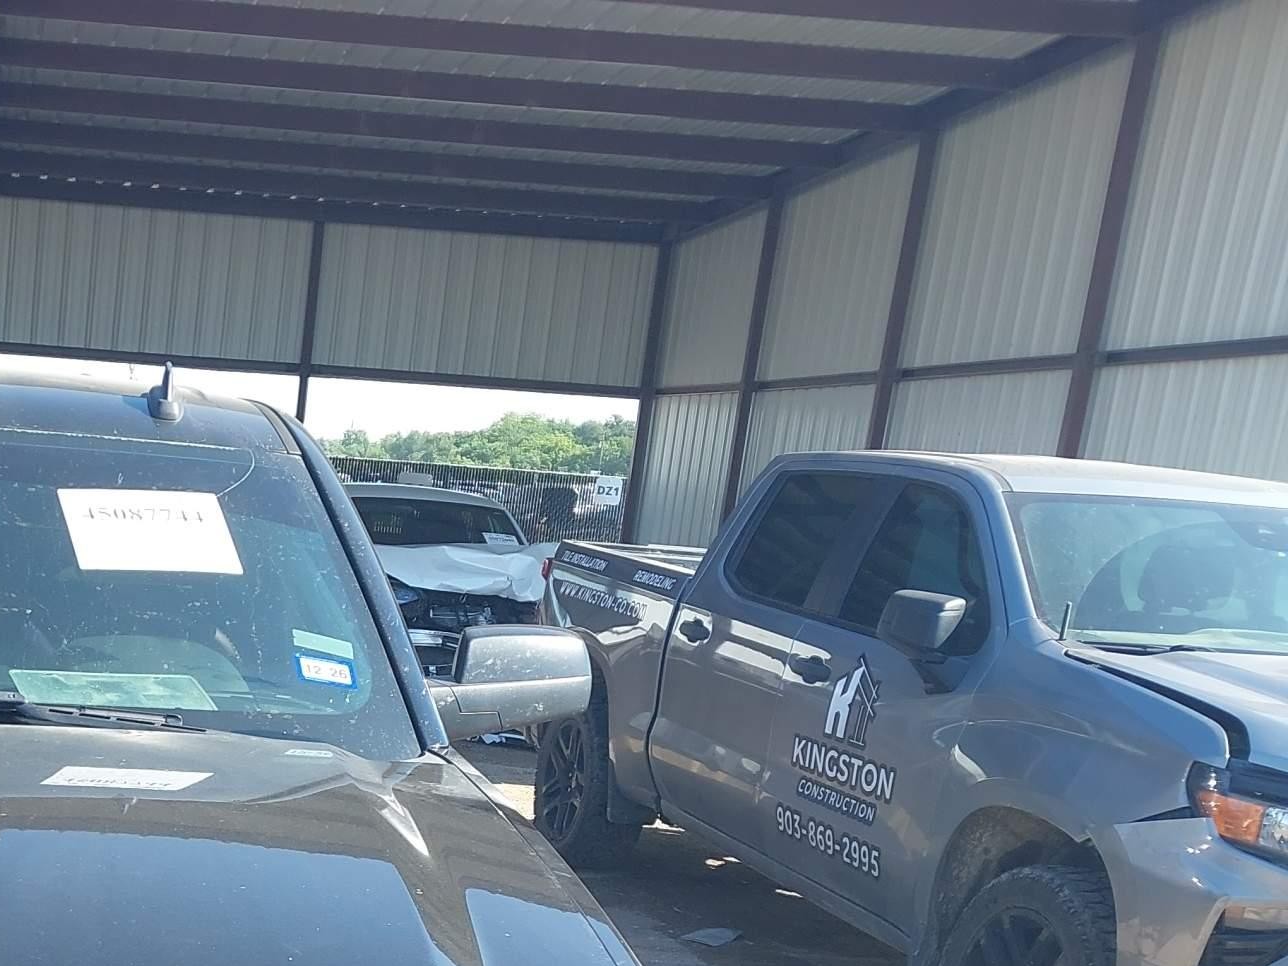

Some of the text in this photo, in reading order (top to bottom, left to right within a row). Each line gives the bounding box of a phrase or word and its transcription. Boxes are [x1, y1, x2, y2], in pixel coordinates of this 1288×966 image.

[597, 486, 619, 496] DZ1
[561, 550, 609, 572] TILE INSTALLATION
[633, 569, 677, 590] REMODELING
[559, 581, 648, 619] WWW.KINGSTON-CO.COM
[305, 663, 348, 680] 12 26
[793, 737, 895, 800] KINGSTON
[798, 779, 875, 822] CONSTRUCTION
[776, 806, 880, 877] 903-869-2995
